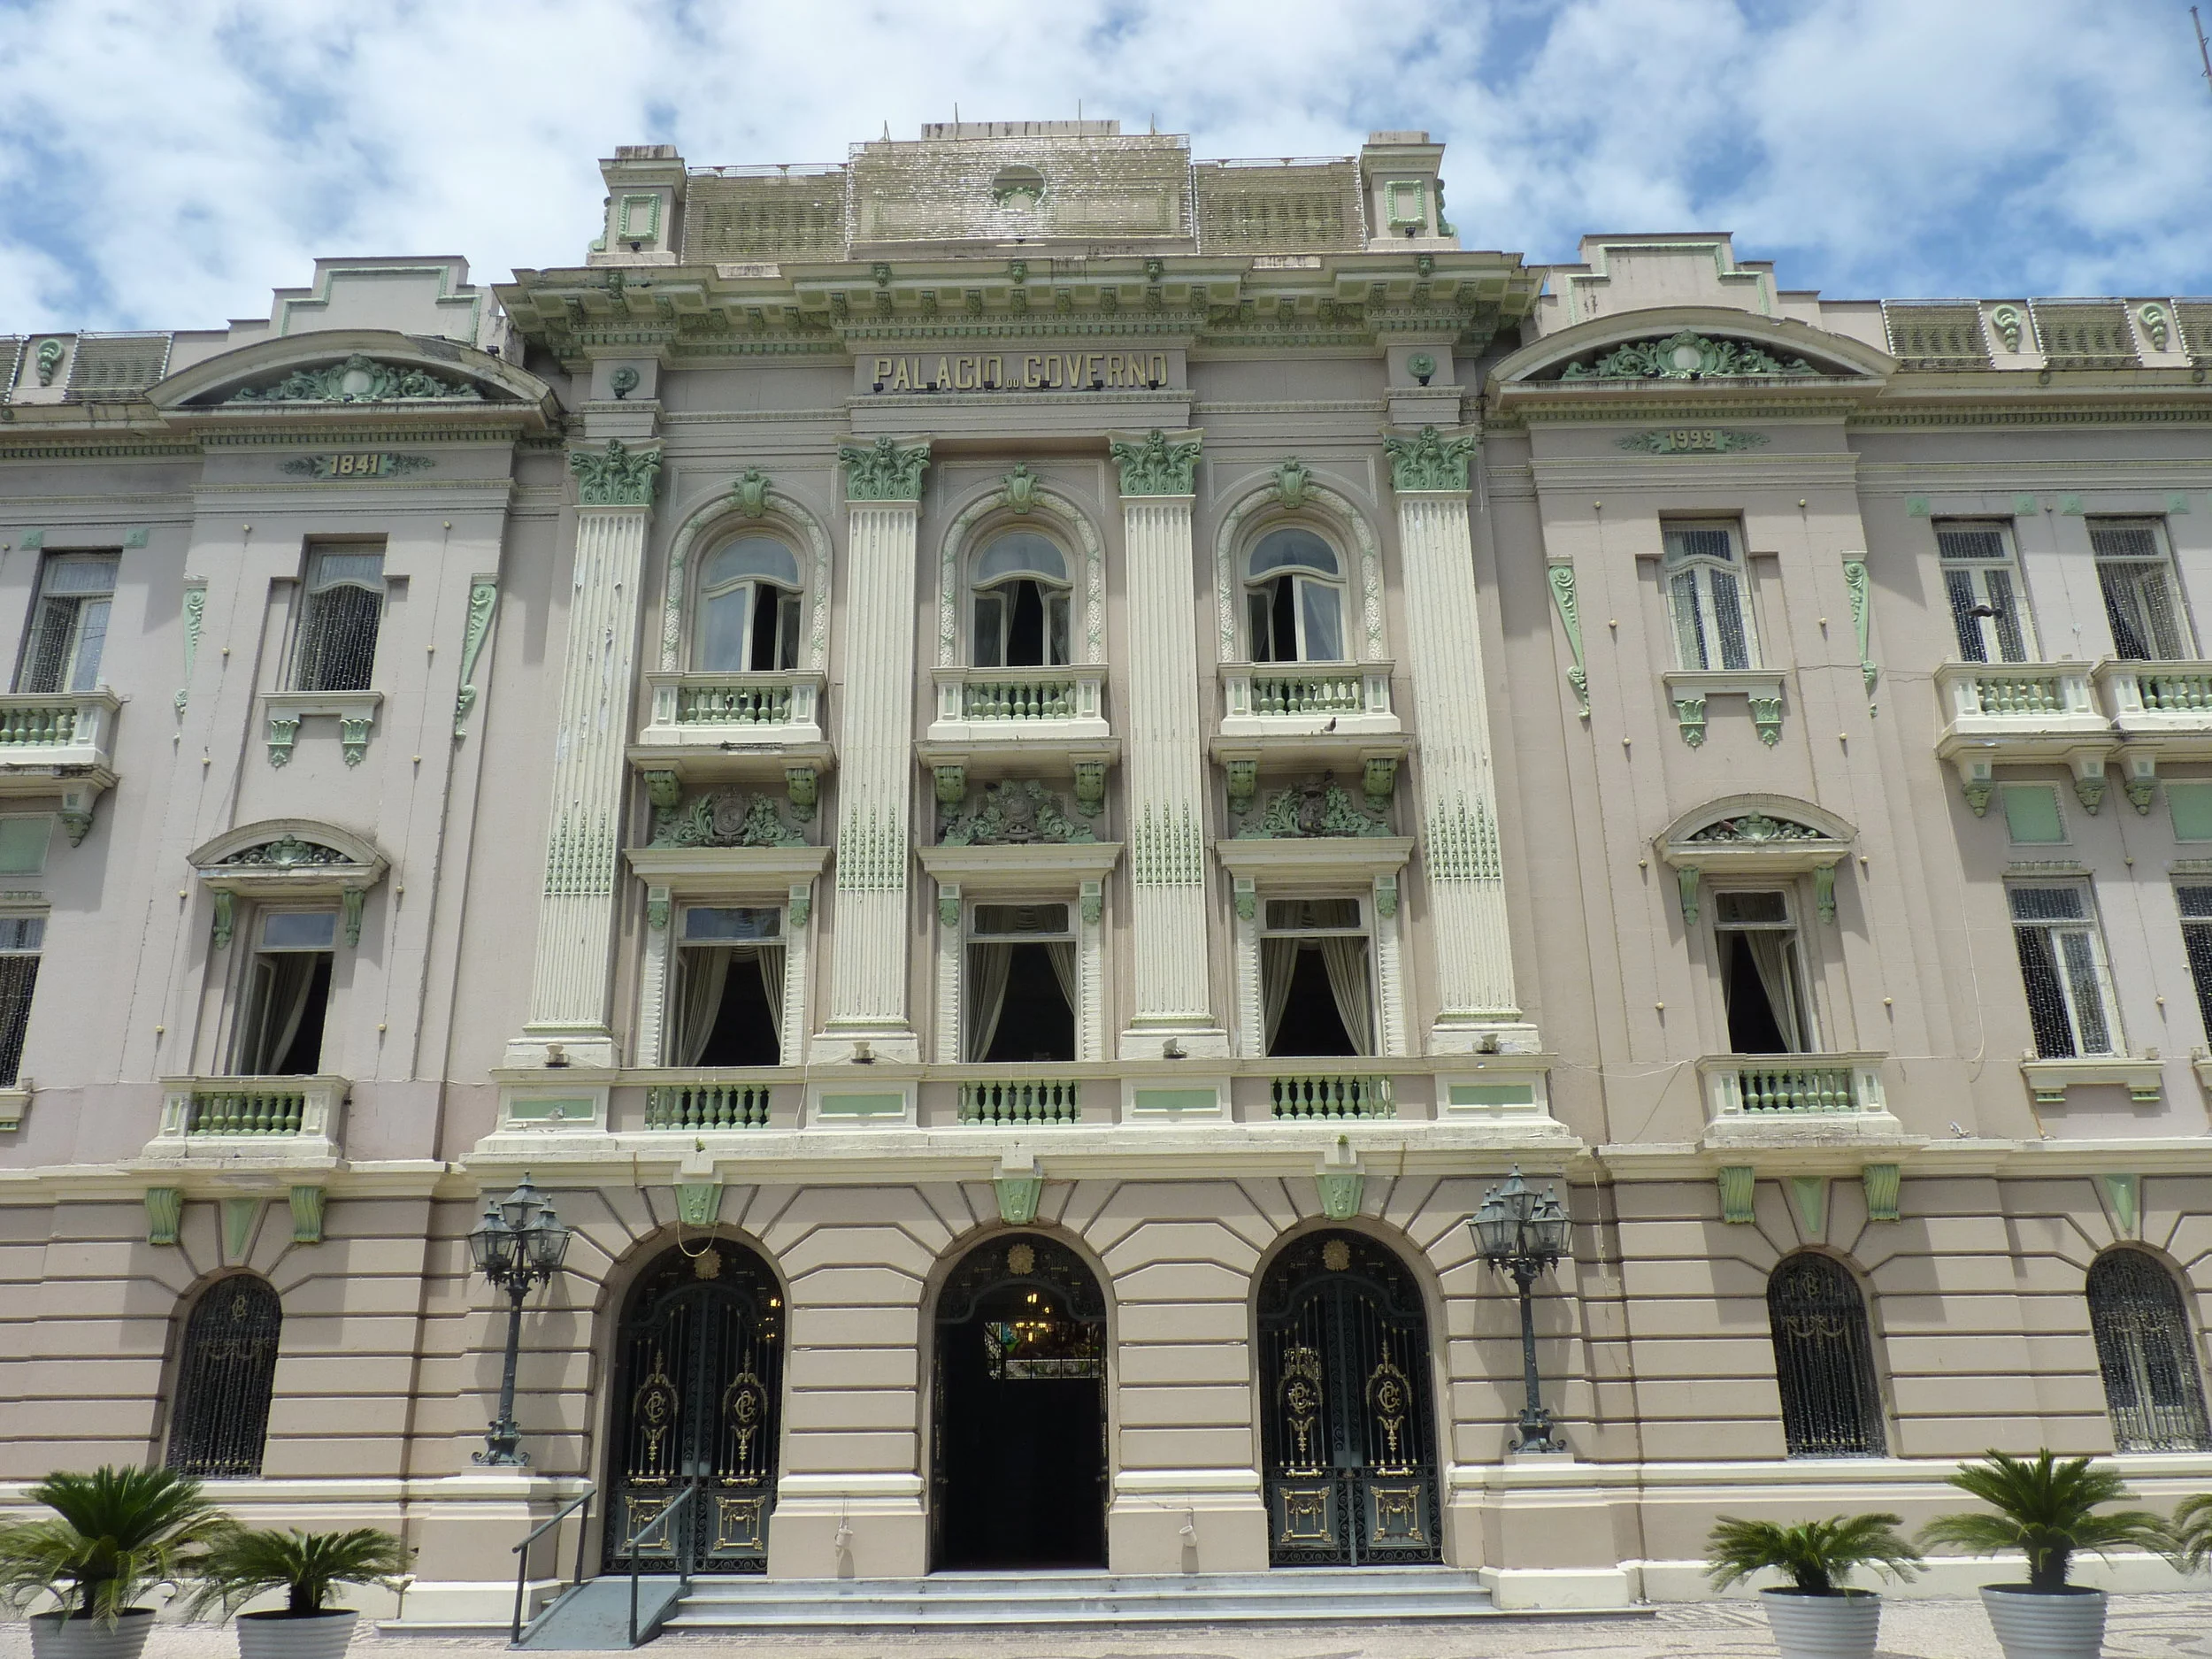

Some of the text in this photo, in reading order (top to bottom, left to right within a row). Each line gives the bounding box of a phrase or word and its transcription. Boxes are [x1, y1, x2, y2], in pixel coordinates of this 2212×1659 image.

[872, 353, 1167, 390] PALACIO DO GOVERNO
[1668, 429, 1717, 449] 1922
[330, 454, 379, 475] 1841
